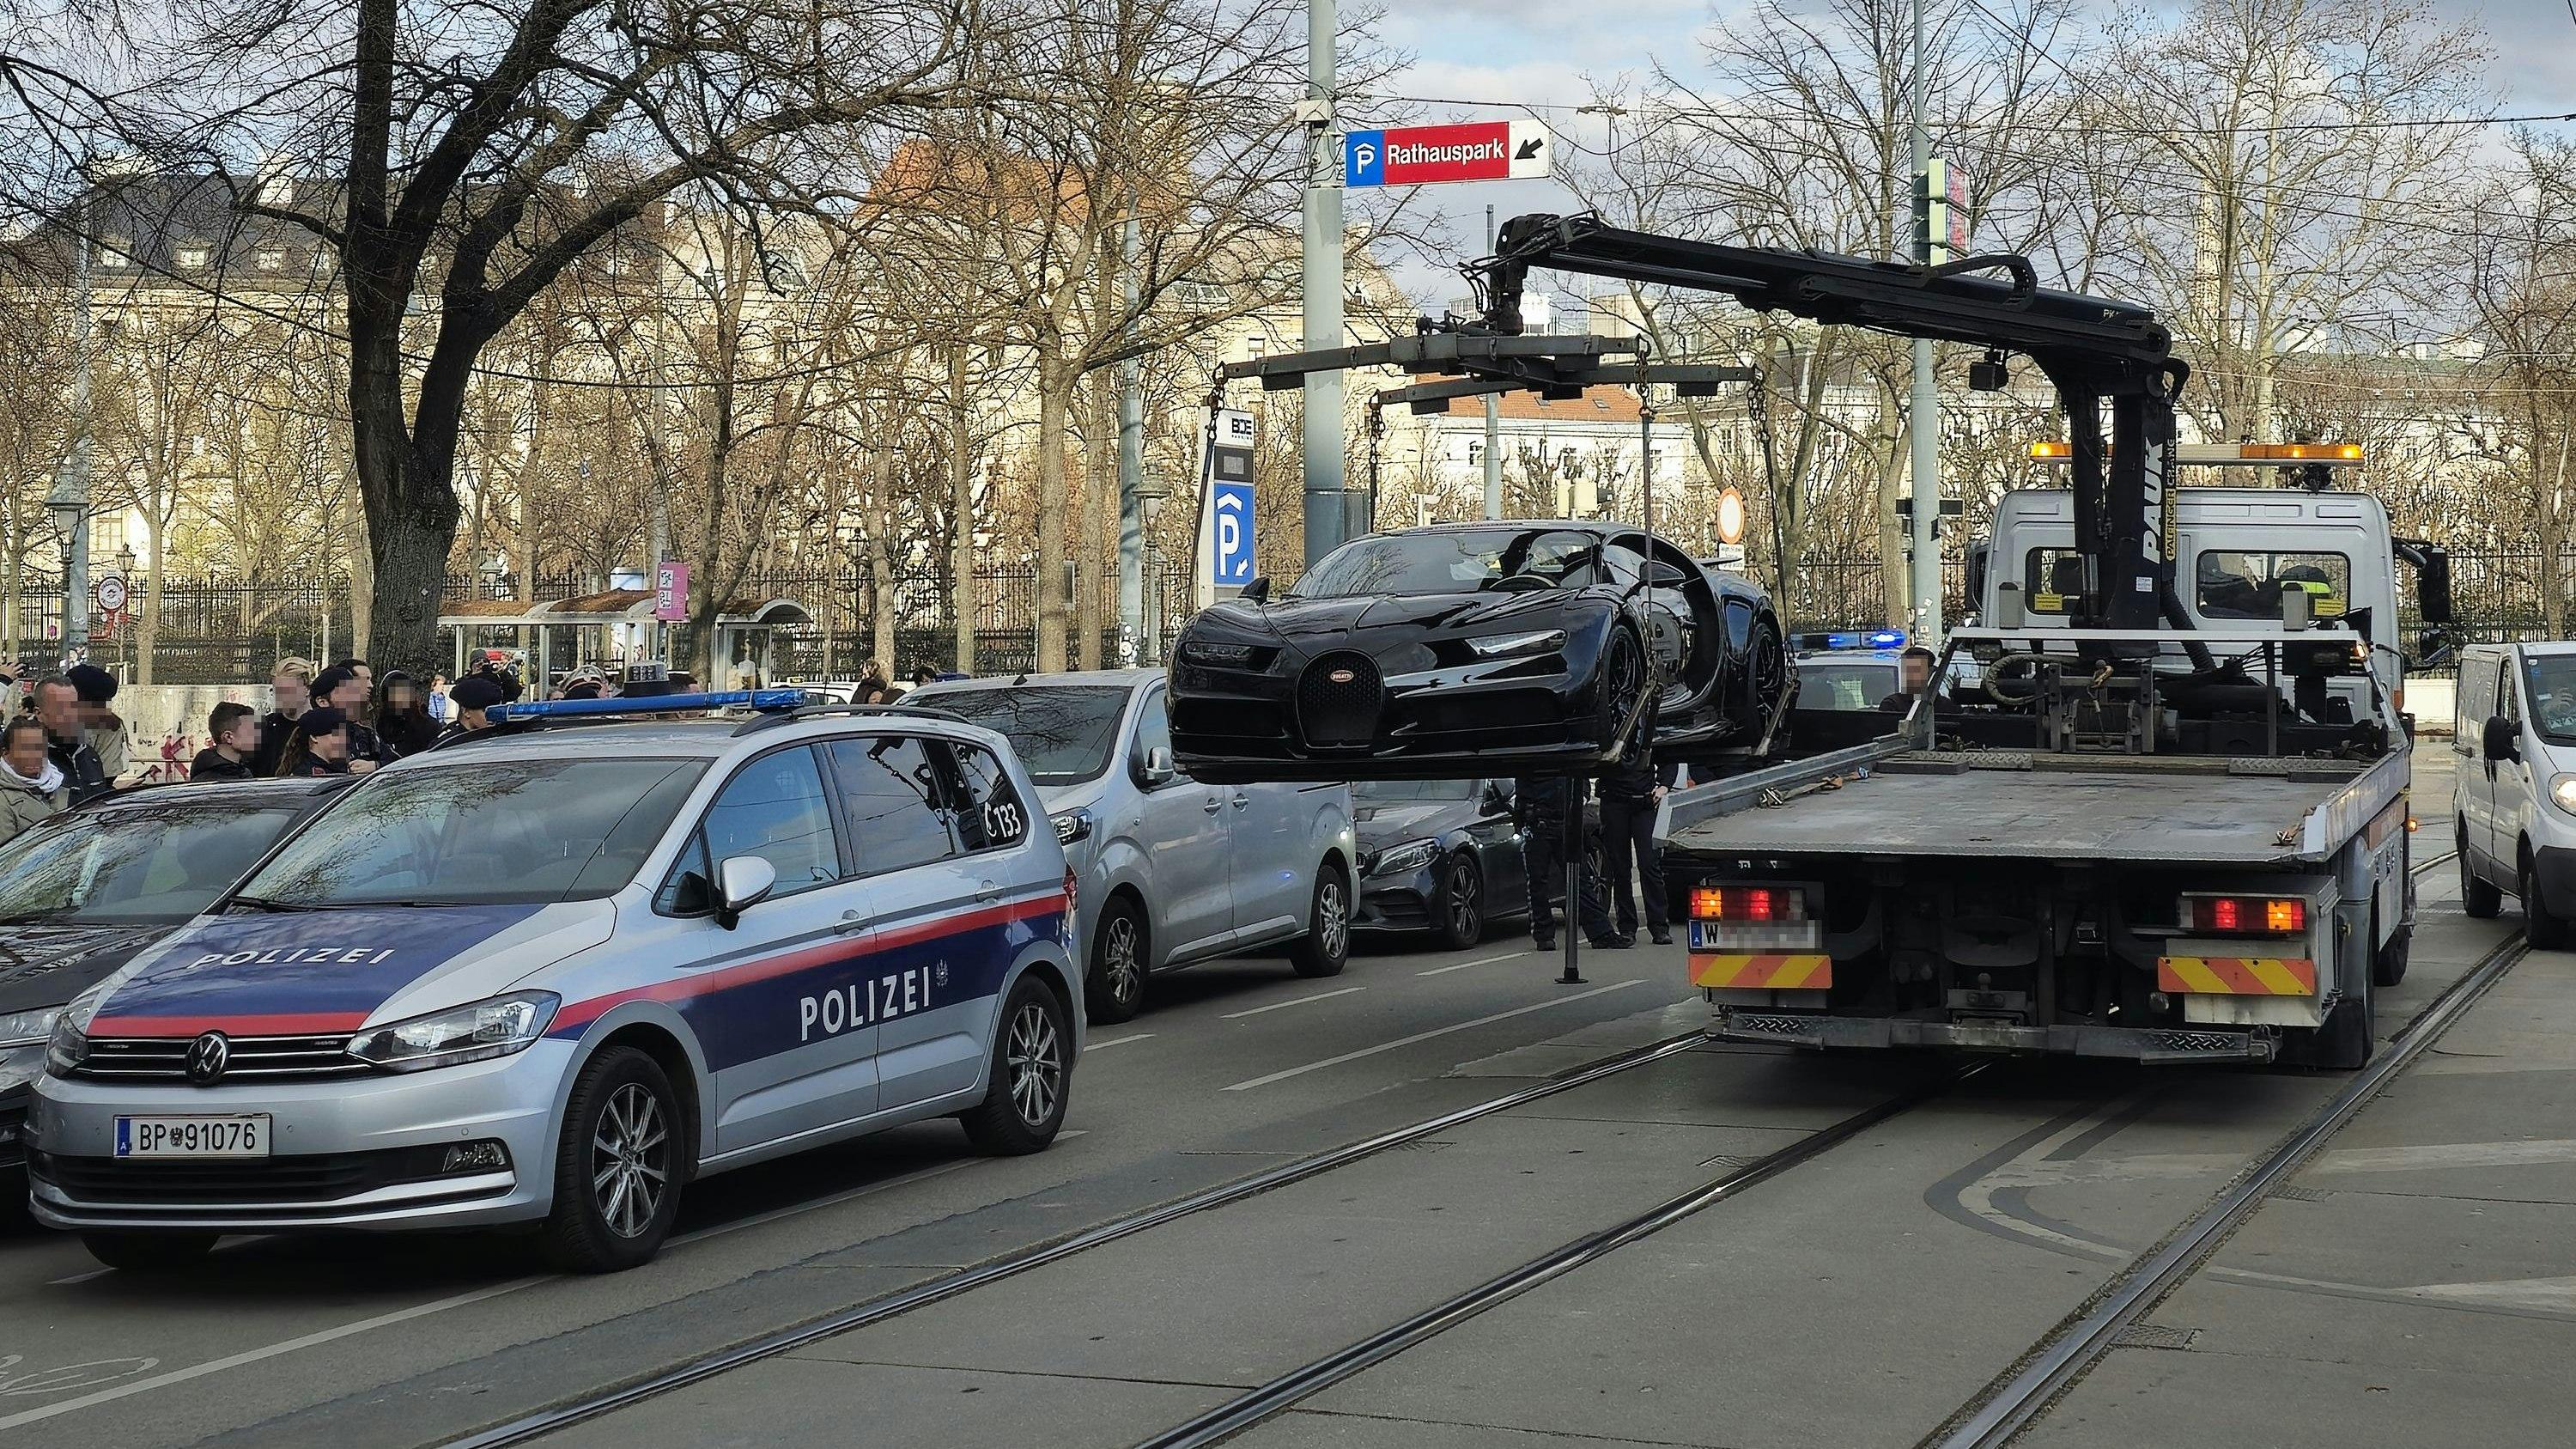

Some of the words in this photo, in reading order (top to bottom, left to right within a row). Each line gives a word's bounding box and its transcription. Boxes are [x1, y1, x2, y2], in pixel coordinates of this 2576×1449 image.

[1388, 137, 1504, 166] Rathauspark
[2143, 436, 2163, 564] PAUK
[2166, 490, 2175, 557] PALFINGER
[993, 802, 1022, 838] 133
[1704, 923, 1718, 944] W
[186, 948, 396, 969] POLIZEI
[800, 966, 930, 1042] POLIZEI
[139, 1123, 167, 1151] BP
[185, 1122, 257, 1151] 91076
